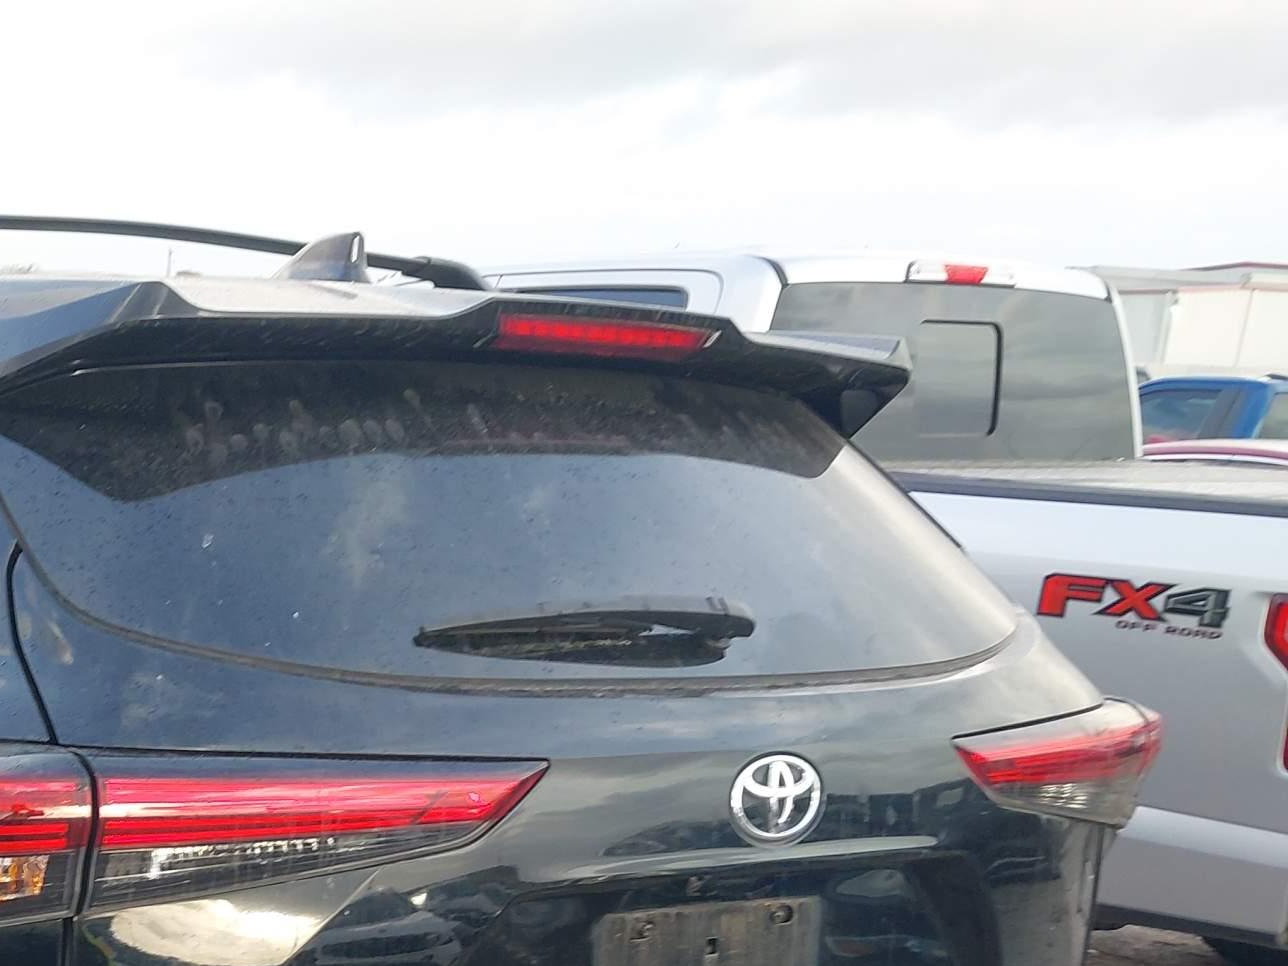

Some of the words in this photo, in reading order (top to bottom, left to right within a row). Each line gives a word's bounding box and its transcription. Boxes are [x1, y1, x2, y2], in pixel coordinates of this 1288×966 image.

[1036, 572, 1232, 629] FX4
[1114, 619, 1158, 633] OFF
[1164, 624, 1223, 641] ROAD
